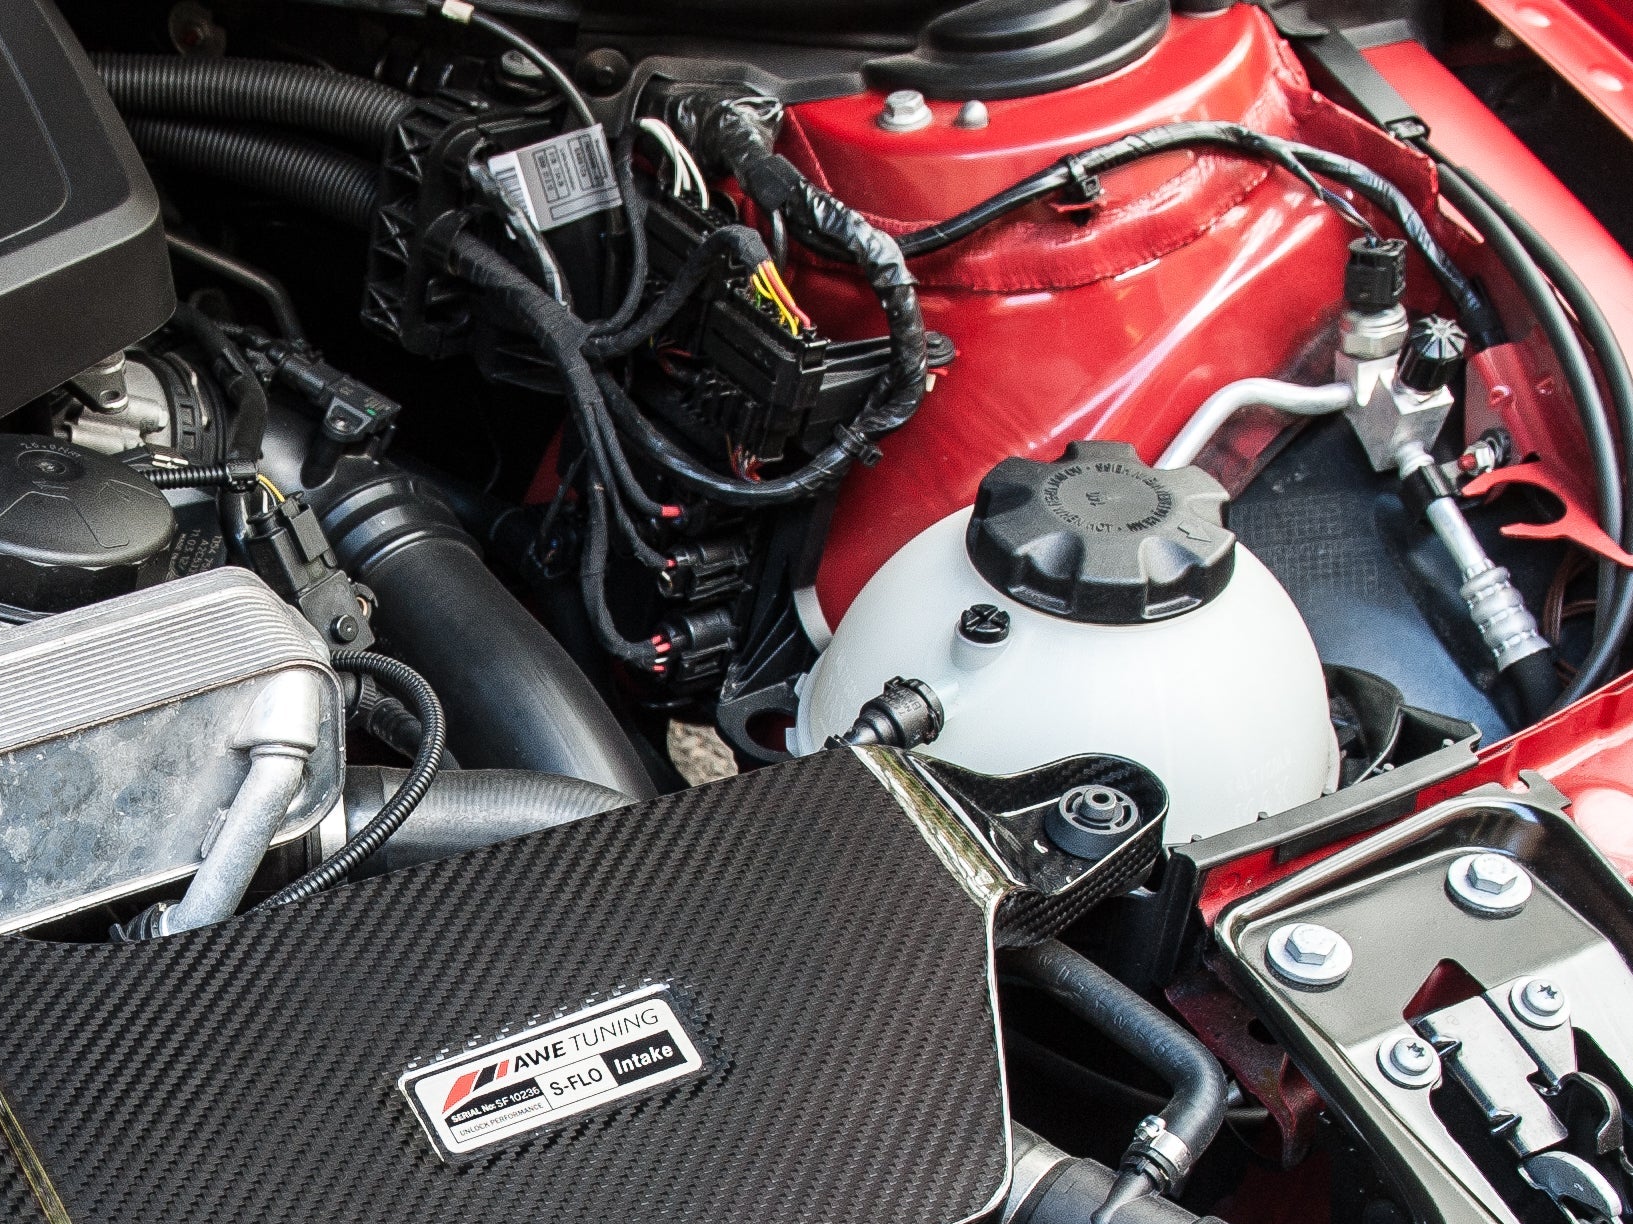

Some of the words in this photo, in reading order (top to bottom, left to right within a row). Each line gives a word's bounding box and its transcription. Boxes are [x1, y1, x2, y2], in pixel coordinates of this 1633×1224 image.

[514, 1040, 566, 1073] AWE
[568, 1008, 659, 1051] TUNING
[549, 1067, 603, 1096] S-FLO
[613, 1045, 674, 1075] Intake
[450, 1107, 482, 1123] SERIAL
[459, 1122, 491, 1137] UNLOCK
[490, 1102, 544, 1126] PERFORMANCE
